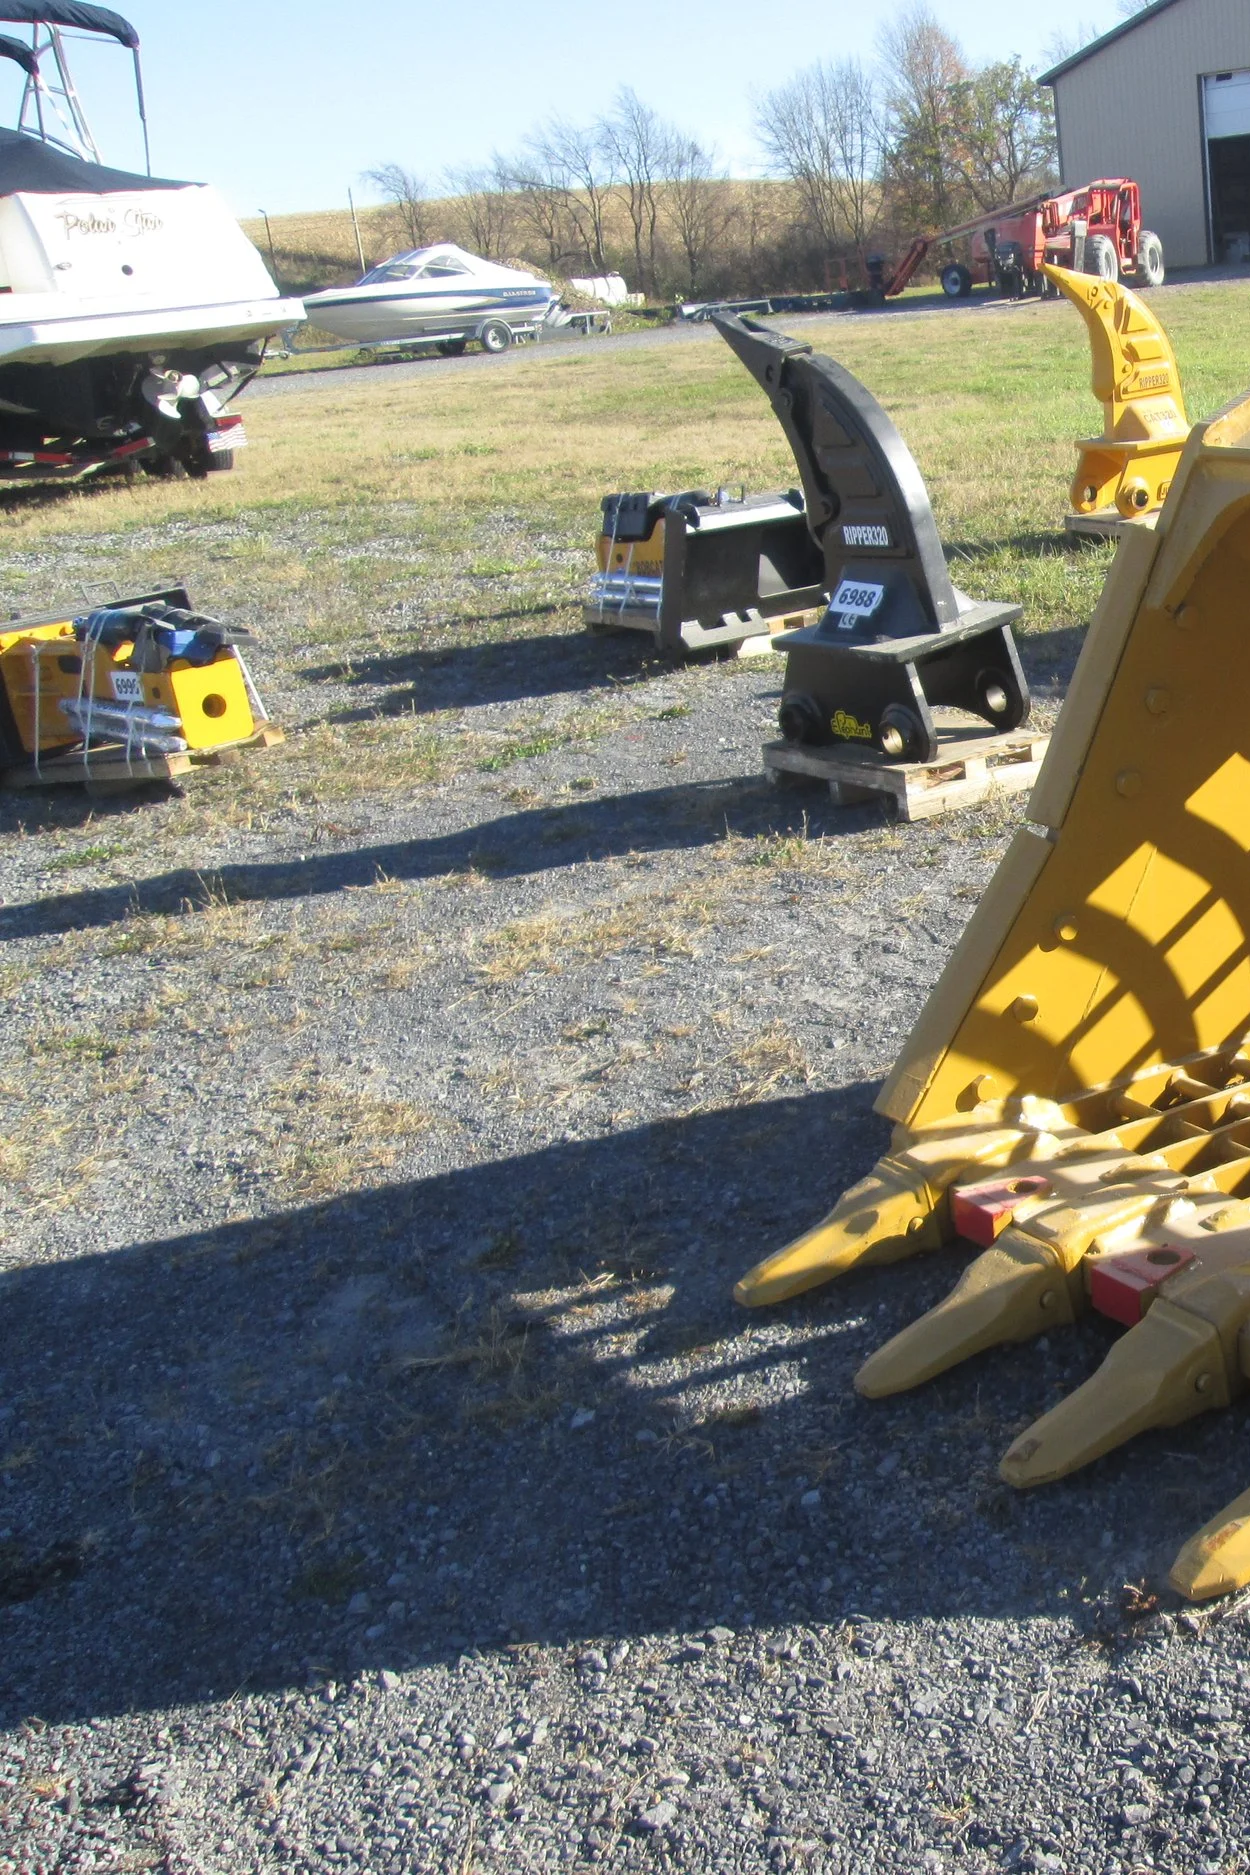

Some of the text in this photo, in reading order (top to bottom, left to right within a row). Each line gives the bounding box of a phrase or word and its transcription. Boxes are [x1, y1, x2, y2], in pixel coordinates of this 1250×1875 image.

[54, 208, 164, 240] Polar Star
[1138, 373, 1169, 389] RIPPER320
[842, 525, 889, 546] RIPPER320
[838, 587, 877, 608] 6988
